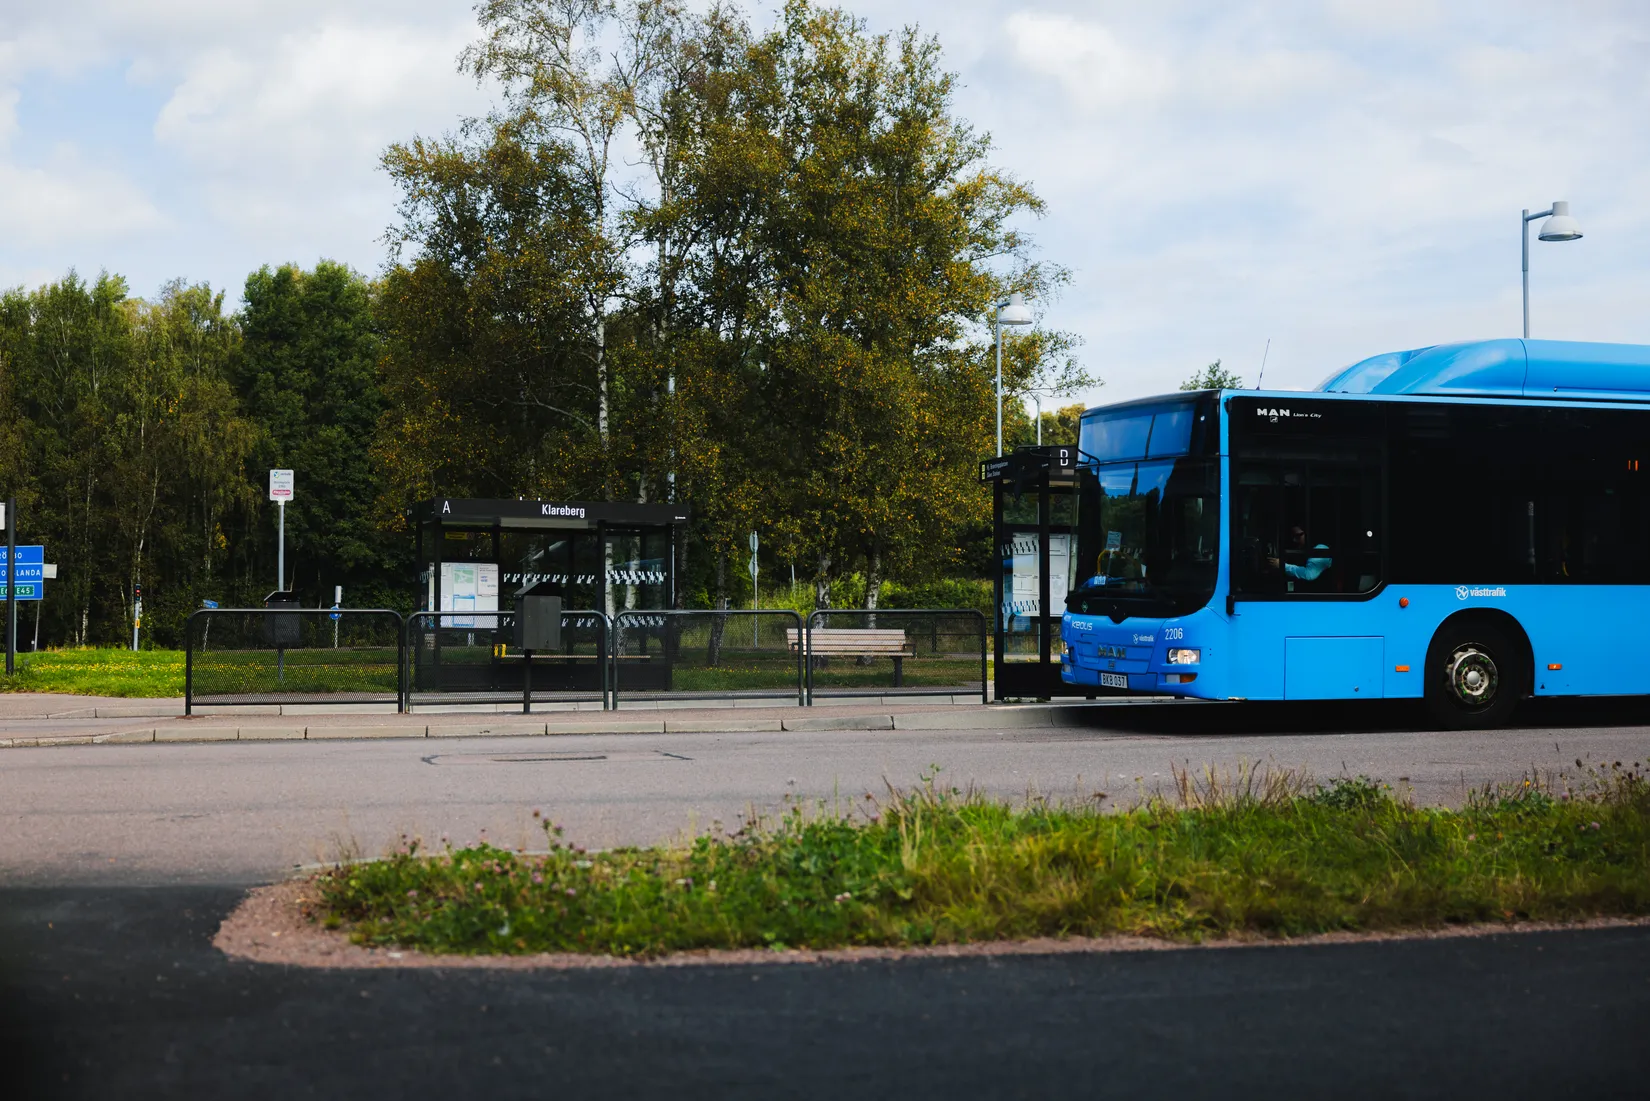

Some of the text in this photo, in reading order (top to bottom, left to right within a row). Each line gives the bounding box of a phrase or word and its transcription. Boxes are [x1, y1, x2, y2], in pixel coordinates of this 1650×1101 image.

[1257, 408, 1290, 417] MAN
[1060, 449, 1069, 466] D
[442, 500, 451, 514] A
[541, 504, 586, 519] Klareberg
[1470, 587, 1506, 596] västtrafik
[1164, 628, 1184, 640] 2206
[1098, 645, 1126, 658] MAN
[1102, 674, 1126, 687] BKB 037
